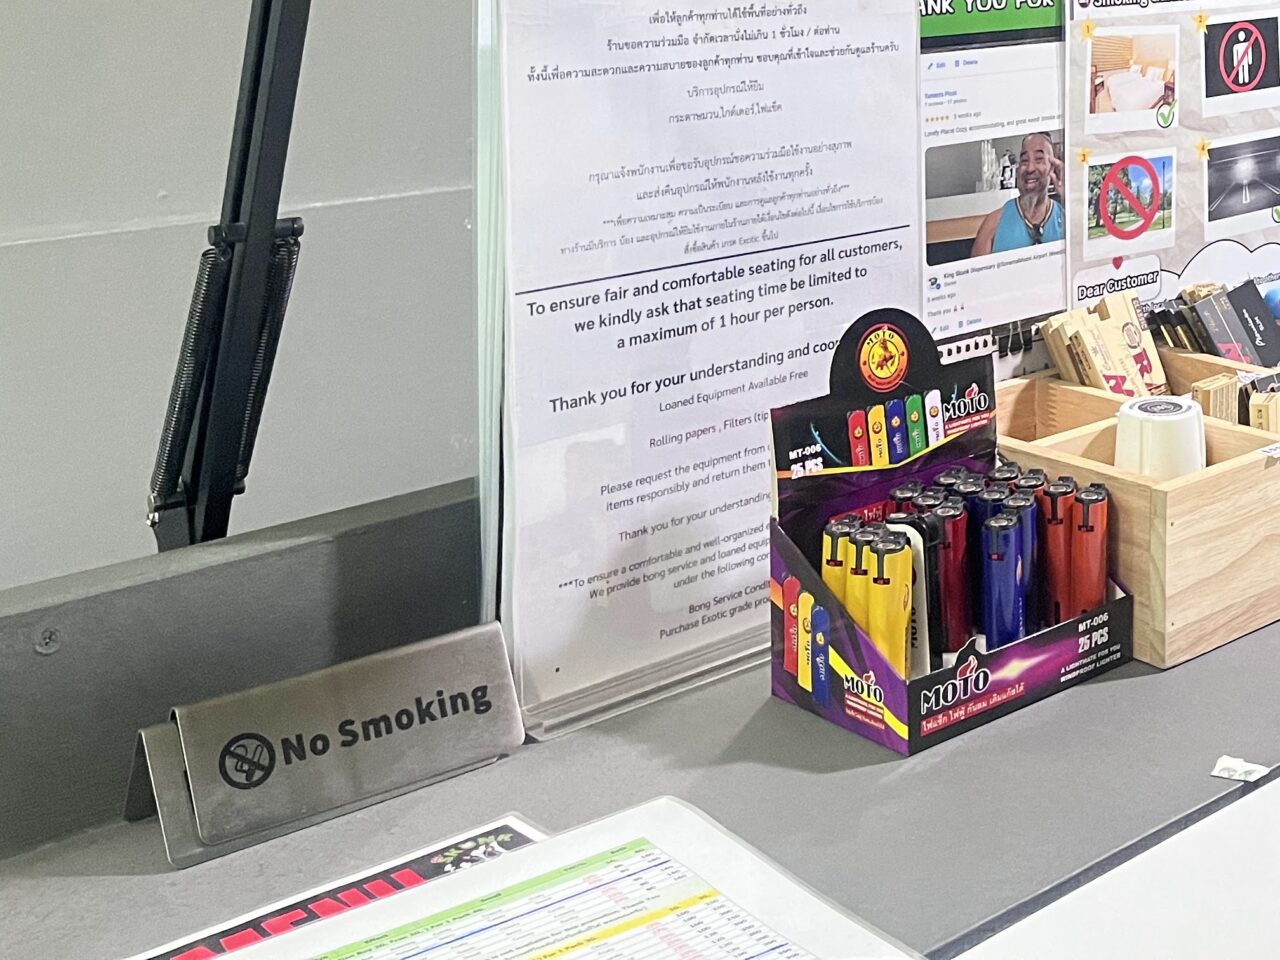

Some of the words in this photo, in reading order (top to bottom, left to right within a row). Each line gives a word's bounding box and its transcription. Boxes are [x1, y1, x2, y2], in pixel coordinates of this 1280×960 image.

[780, 24, 804, 37] ชั่วโมง
[527, 302, 545, 317] To
[550, 293, 600, 313] ensure
[605, 287, 628, 302] fair
[633, 280, 658, 297] and
[662, 266, 745, 291] comfortable
[749, 258, 795, 276] seating
[800, 254, 817, 267] for
[820, 248, 835, 262] all
[838, 240, 902, 259] customers,
[1078, 282, 1105, 301] Dear
[1106, 271, 1159, 293] Customer
[600, 308, 642, 327] kindly
[646, 303, 669, 319] ask
[673, 297, 702, 313] that
[706, 289, 754, 307] seating
[758, 283, 787, 297] time
[808, 267, 851, 287] limited
[629, 323, 697, 346] maximum
[730, 309, 759, 325] hour
[764, 305, 785, 322] per
[788, 296, 834, 317] person.
[1132, 297, 1149, 331] CLASSIC
[867, 330, 895, 345] MOTO
[550, 391, 596, 413] Thank
[600, 387, 627, 405] you
[631, 381, 651, 395] for
[654, 373, 686, 392] your
[689, 350, 784, 381] understanding
[787, 343, 810, 359] and
[659, 397, 694, 412] Loaned
[697, 385, 745, 404] Equipment
[748, 375, 787, 391] Available
[789, 371, 808, 381] Free
[943, 393, 989, 422] MOTO
[649, 433, 683, 448] Rolling
[685, 425, 717, 442] papers
[723, 415, 752, 430] Filters
[789, 444, 821, 460] MT-006
[601, 480, 632, 496] Please
[635, 470, 672, 487] request
[675, 463, 690, 476] the
[693, 452, 741, 471] equipment
[744, 447, 765, 458] from
[791, 462, 804, 480] 25
[805, 457, 823, 477] PCS
[606, 498, 633, 512] items
[636, 481, 690, 503] responsibly
[692, 475, 710, 488] and
[712, 469, 740, 482] return
[742, 462, 766, 474] them
[619, 527, 648, 542] Thank
[650, 522, 669, 535] you
[671, 517, 685, 527] for
[686, 511, 707, 526] your
[587, 569, 619, 585] ensure
[628, 549, 683, 572] comfortable
[685, 544, 701, 555] and
[703, 523, 764, 550] well-organized
[606, 577, 640, 597] provide
[643, 570, 666, 583] bong
[667, 561, 698, 575] service
[700, 553, 716, 565] and
[718, 544, 746, 559] loaned
[673, 575, 698, 588] under
[701, 568, 715, 579] the
[717, 557, 755, 575] following
[688, 601, 711, 614] Bong
[713, 590, 742, 605] Service
[659, 620, 699, 639] Purchase
[702, 610, 727, 625] Exotic
[729, 601, 752, 617] grade
[1078, 612, 1109, 633] MT-006
[1078, 634, 1090, 654] 25
[1092, 626, 1109, 647] PCS
[1098, 649, 1108, 658] FOR
[1060, 664, 1095, 683] WINDPROOF
[1097, 652, 1121, 668] LIGHTER
[844, 674, 884, 703] MOTO
[921, 668, 991, 714] MOTO
[280, 733, 331, 765] No
[338, 685, 492, 748] Smoking
